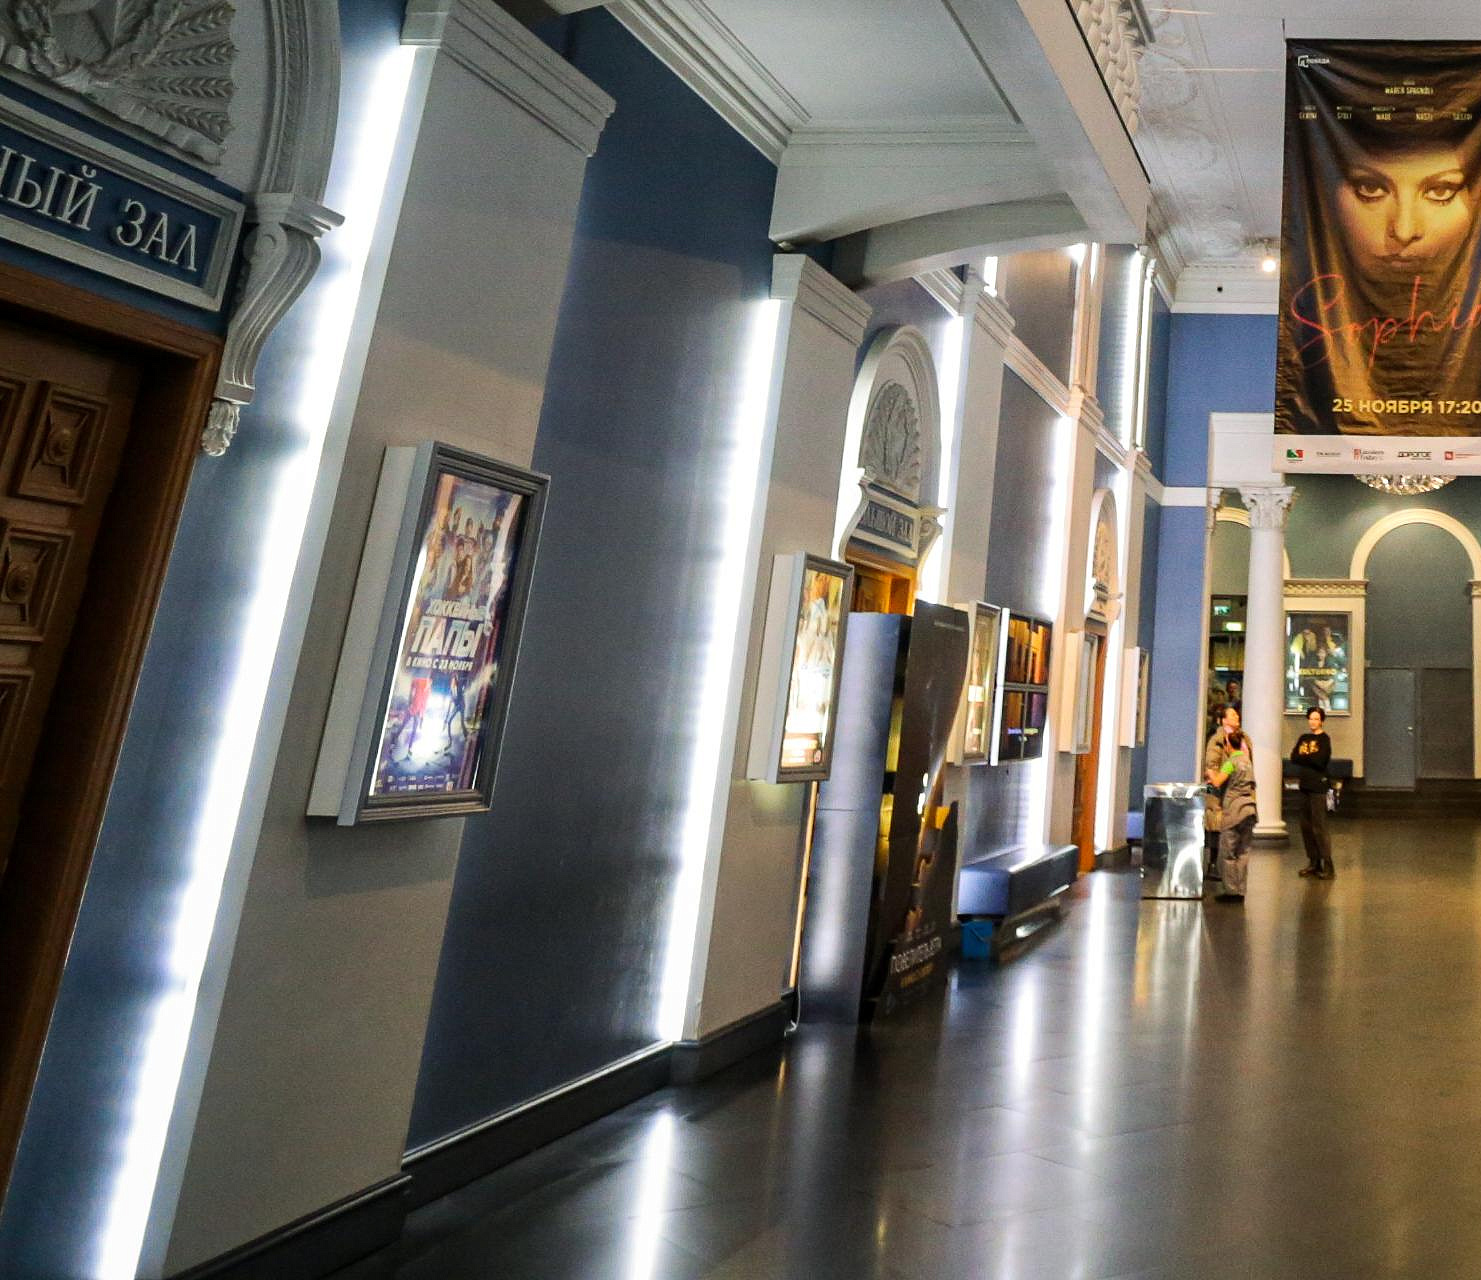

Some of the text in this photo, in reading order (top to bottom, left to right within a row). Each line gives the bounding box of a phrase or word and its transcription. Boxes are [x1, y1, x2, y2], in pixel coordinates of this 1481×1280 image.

[116, 198, 198, 272] ЗАЛ
[1332, 398, 1352, 413] 25
[1358, 399, 1434, 415] НОЯБРЯ
[410, 615, 484, 659] ПАПЫ
